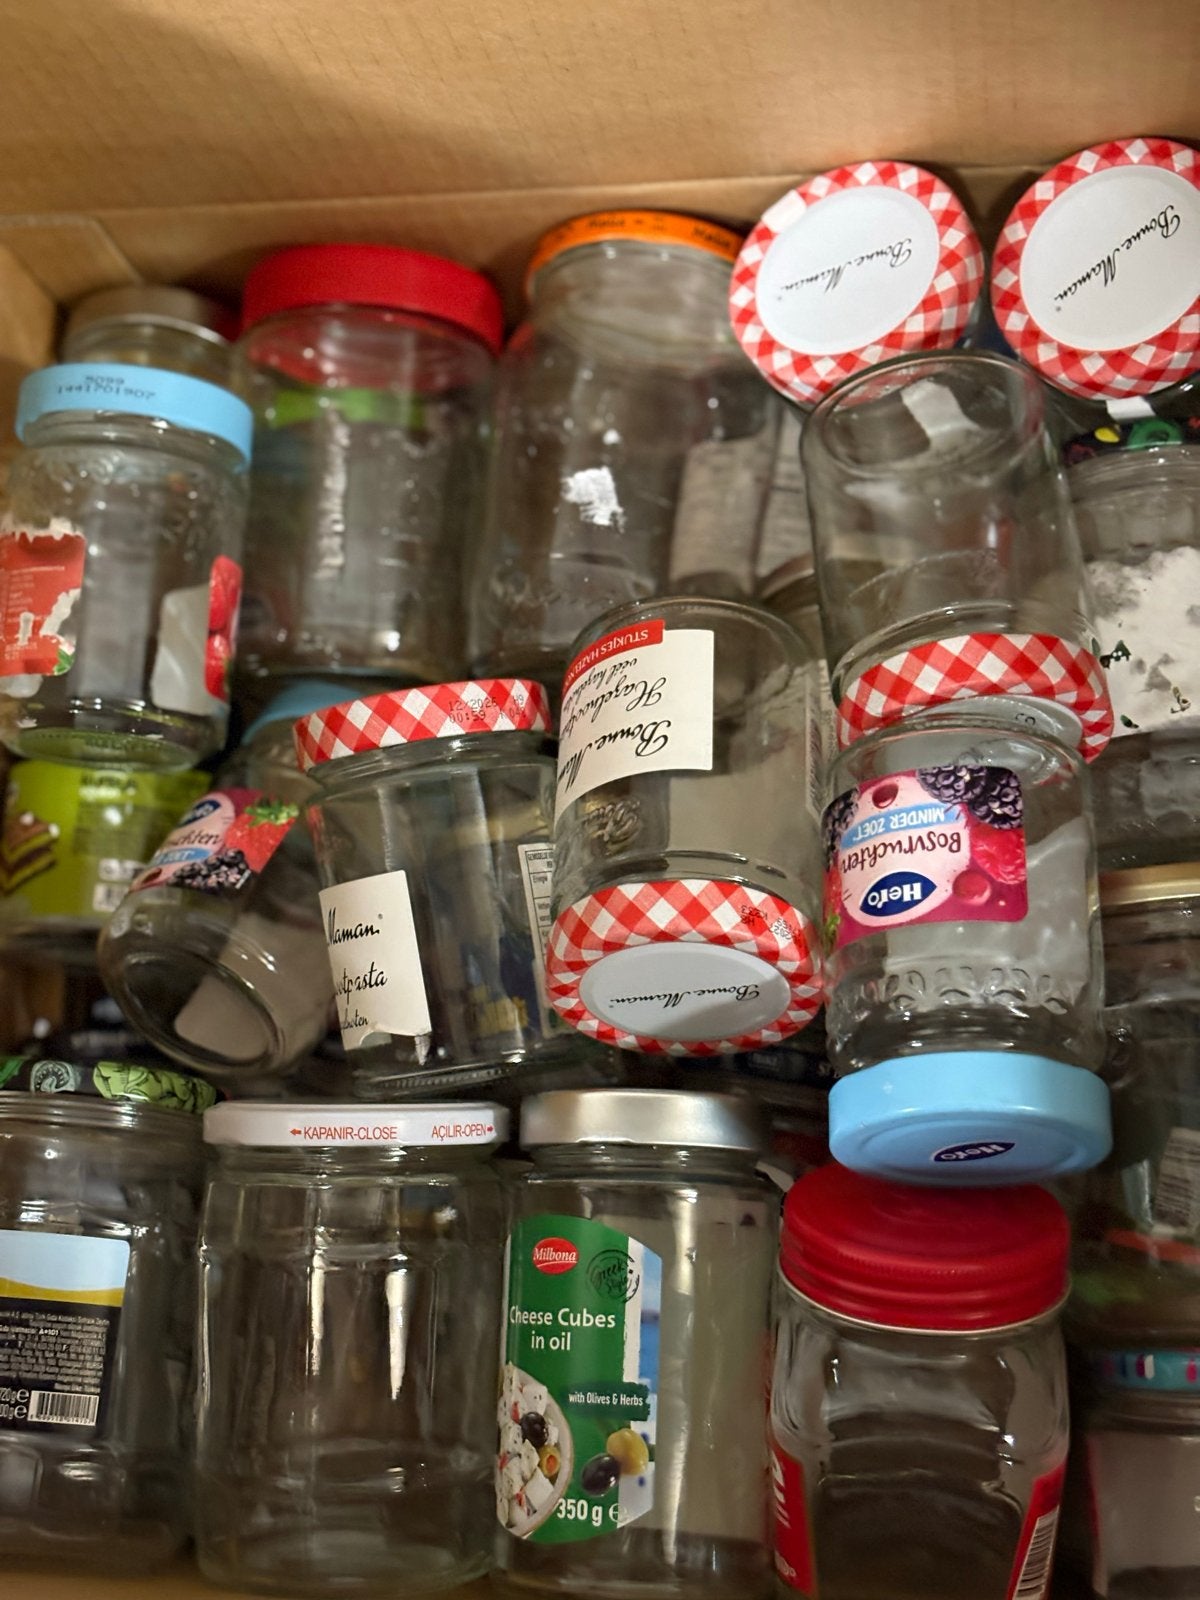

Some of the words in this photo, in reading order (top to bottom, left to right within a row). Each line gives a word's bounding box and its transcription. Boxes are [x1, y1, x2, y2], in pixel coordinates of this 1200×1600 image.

[1120, 204, 1180, 250] Bonne
[853, 238, 912, 268] Bonne
[1053, 247, 1120, 301] Maman
[601, 629, 649, 655] STUKJES
[595, 719, 672, 757] Bonne
[890, 807, 945, 830] MINDER
[842, 830, 961, 873] Bosvruchten
[867, 882, 922, 908] Hero
[610, 991, 690, 1009] Maman
[696, 984, 760, 1000] Bonne
[304, 1126, 398, 1140] KAPANIR-CLOSE
[432, 1123, 487, 1141] AÇILIR-OPEN
[940, 1144, 1006, 1160] Hero
[533, 1247, 577, 1262] Milbona
[509, 1305, 553, 1326] Cheese
[557, 1307, 616, 1329] Cubes
[530, 1330, 545, 1350] in
[549, 1331, 572, 1351] oil
[568, 1391, 585, 1403] with
[586, 1392, 611, 1405] Olives
[612, 1393, 618, 1405] &
[620, 1394, 644, 1406] Herbs
[557, 1498, 588, 1520] 350
[592, 1504, 603, 1527] g
